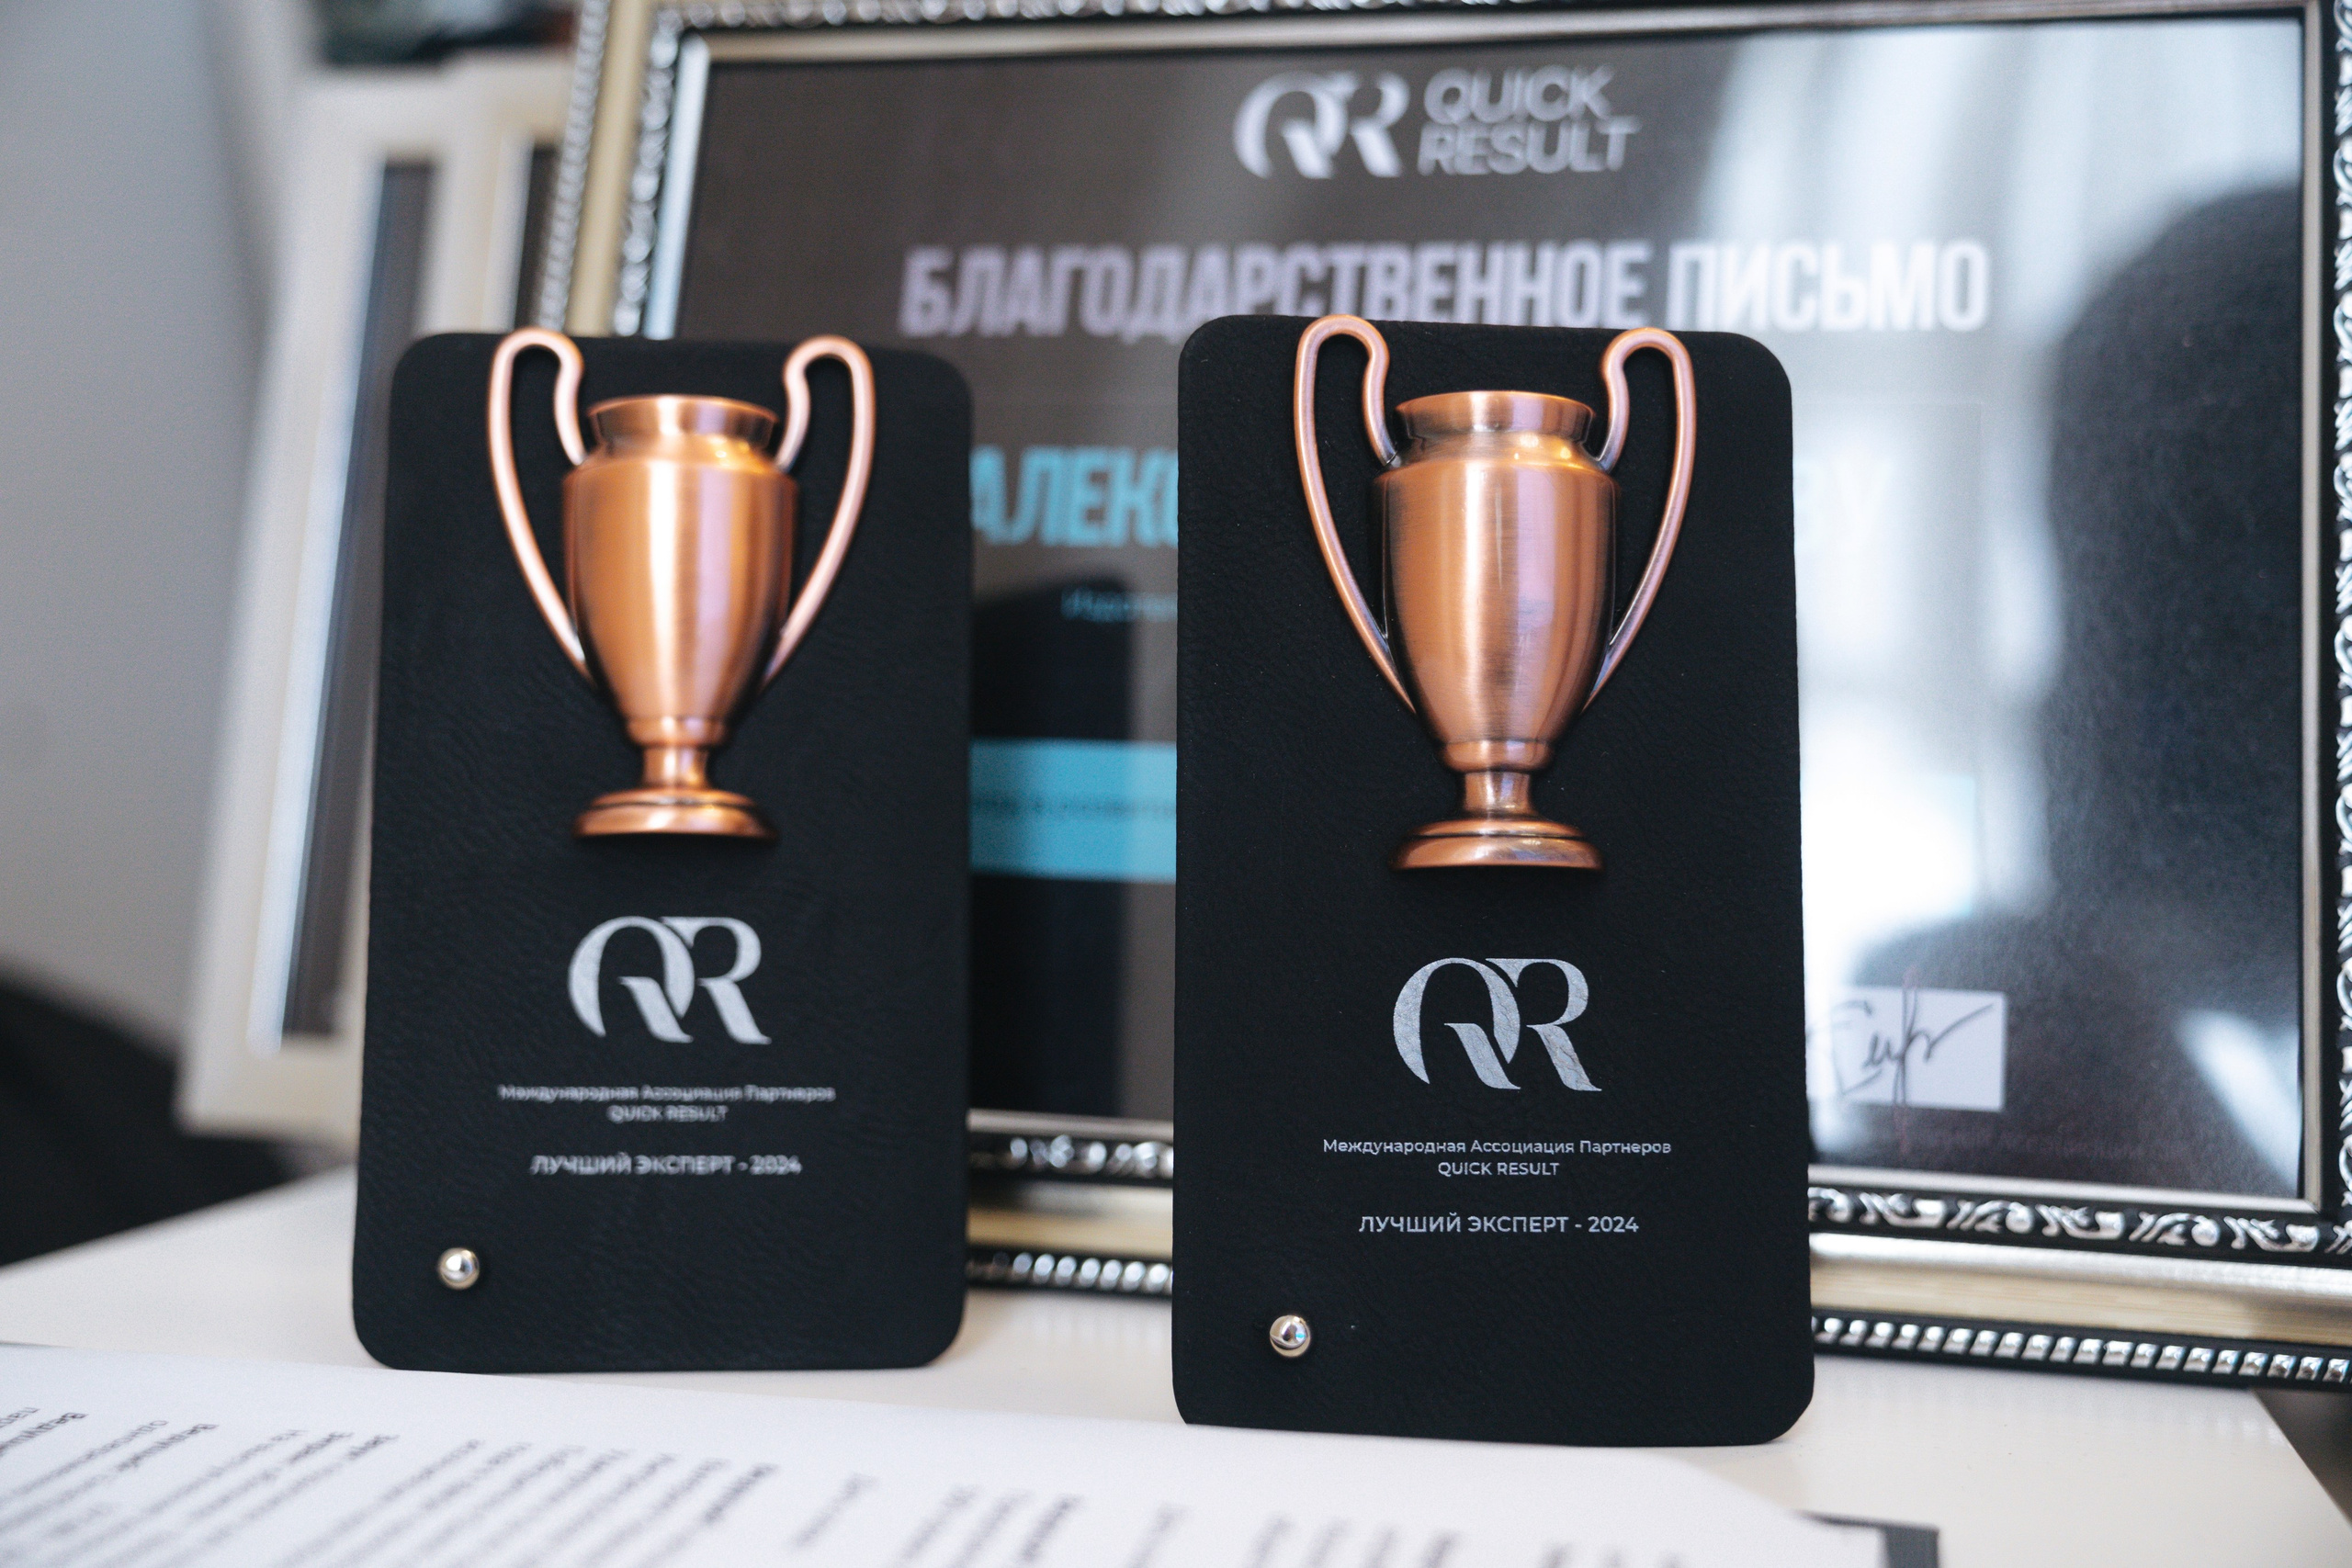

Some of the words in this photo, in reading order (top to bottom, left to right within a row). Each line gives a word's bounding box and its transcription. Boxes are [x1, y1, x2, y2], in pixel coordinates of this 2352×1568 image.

[1424, 66, 1614, 124] QUICK
[1418, 117, 1642, 175] RESULT
[900, 243, 1650, 344] БЛАГОДАРСТВЕННОЕ
[1666, 242, 1988, 331] ПИСЬМО
[497, 1085, 639, 1101] Международная
[642, 1085, 743, 1101] Ассоциация
[744, 1085, 836, 1103] Партнеров
[606, 1105, 663, 1123] QUICK
[665, 1105, 729, 1122] RESULT
[1323, 1138, 1466, 1156] Международная
[1470, 1139, 1575, 1156] Ассоциация
[1579, 1139, 1672, 1156] Партнеров
[530, 1152, 632, 1176] ЛУЧШИЙ
[634, 1155, 736, 1176] ЭКСПЕРТ
[749, 1155, 803, 1176] 2024
[1438, 1161, 1493, 1178] QUICK
[1497, 1162, 1560, 1176] RESULT
[1358, 1212, 1462, 1233] ЛУЧШИЙ
[1466, 1215, 1569, 1233] ЭКСПЕРТ
[1587, 1215, 1640, 1233] 2024
